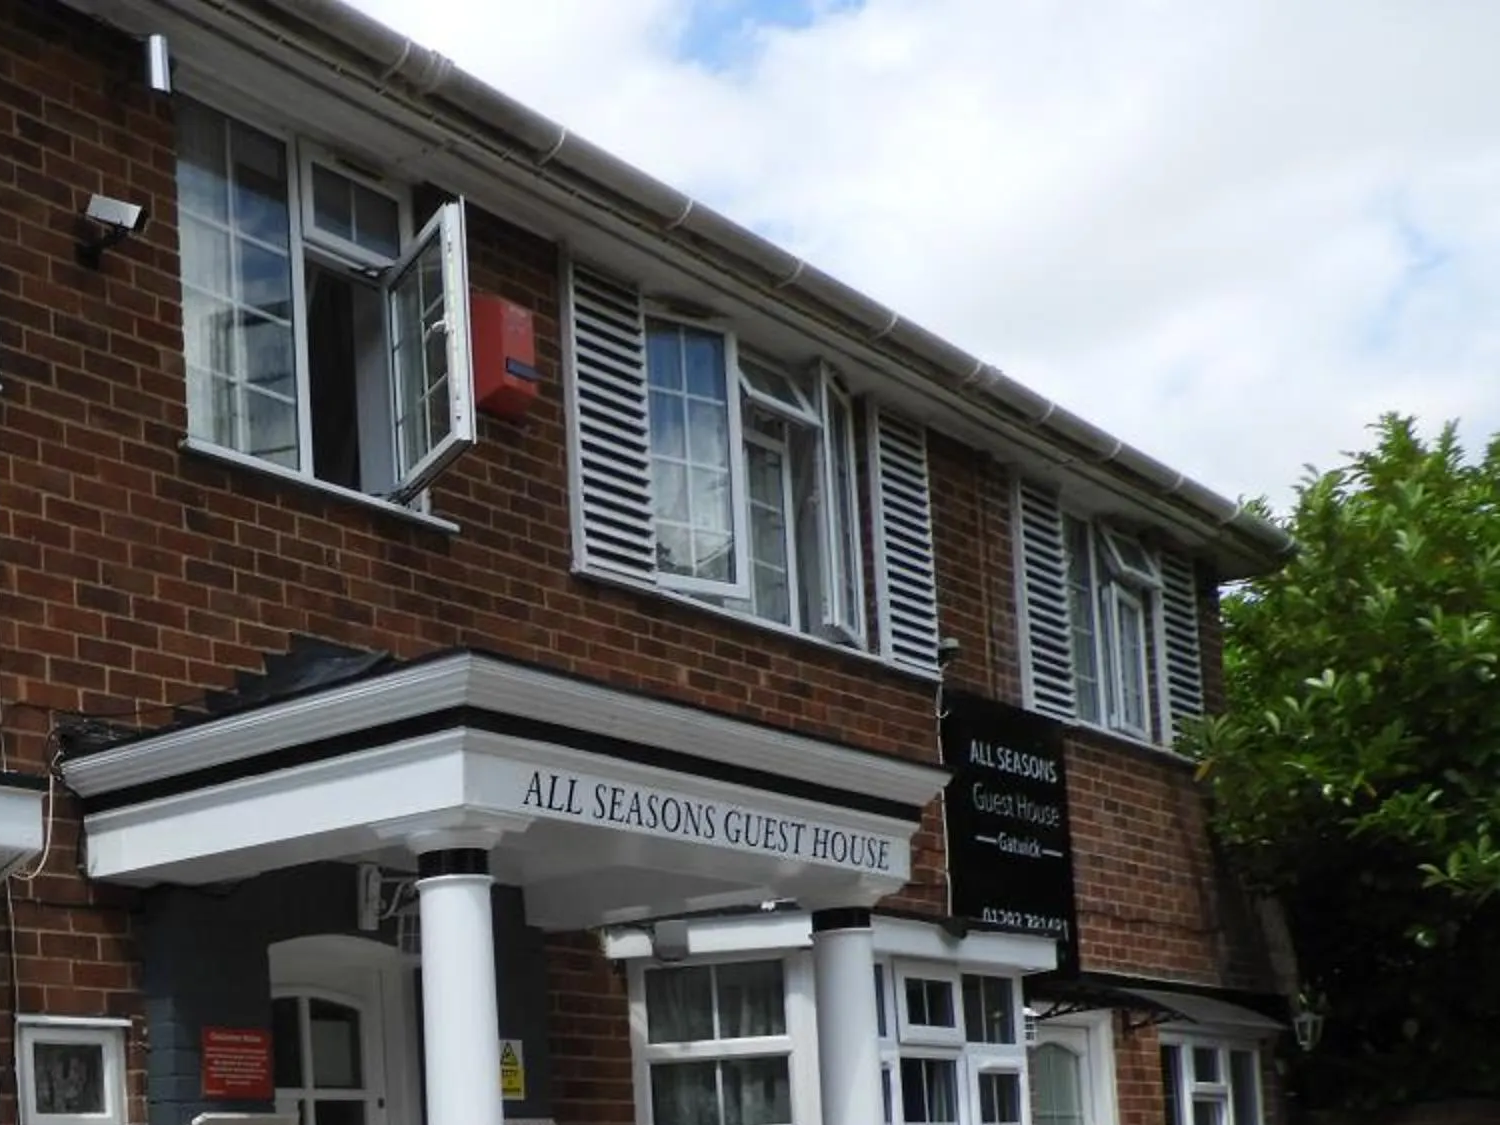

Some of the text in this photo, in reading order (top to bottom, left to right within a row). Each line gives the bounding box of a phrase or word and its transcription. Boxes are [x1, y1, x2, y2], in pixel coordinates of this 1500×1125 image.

[970, 739, 1057, 783] ALL SEASONS
[522, 770, 891, 871] ALL SEASONS GUEST HOUSE
[973, 782, 1060, 827] Guest House
[998, 831, 1041, 857] Gatwick
